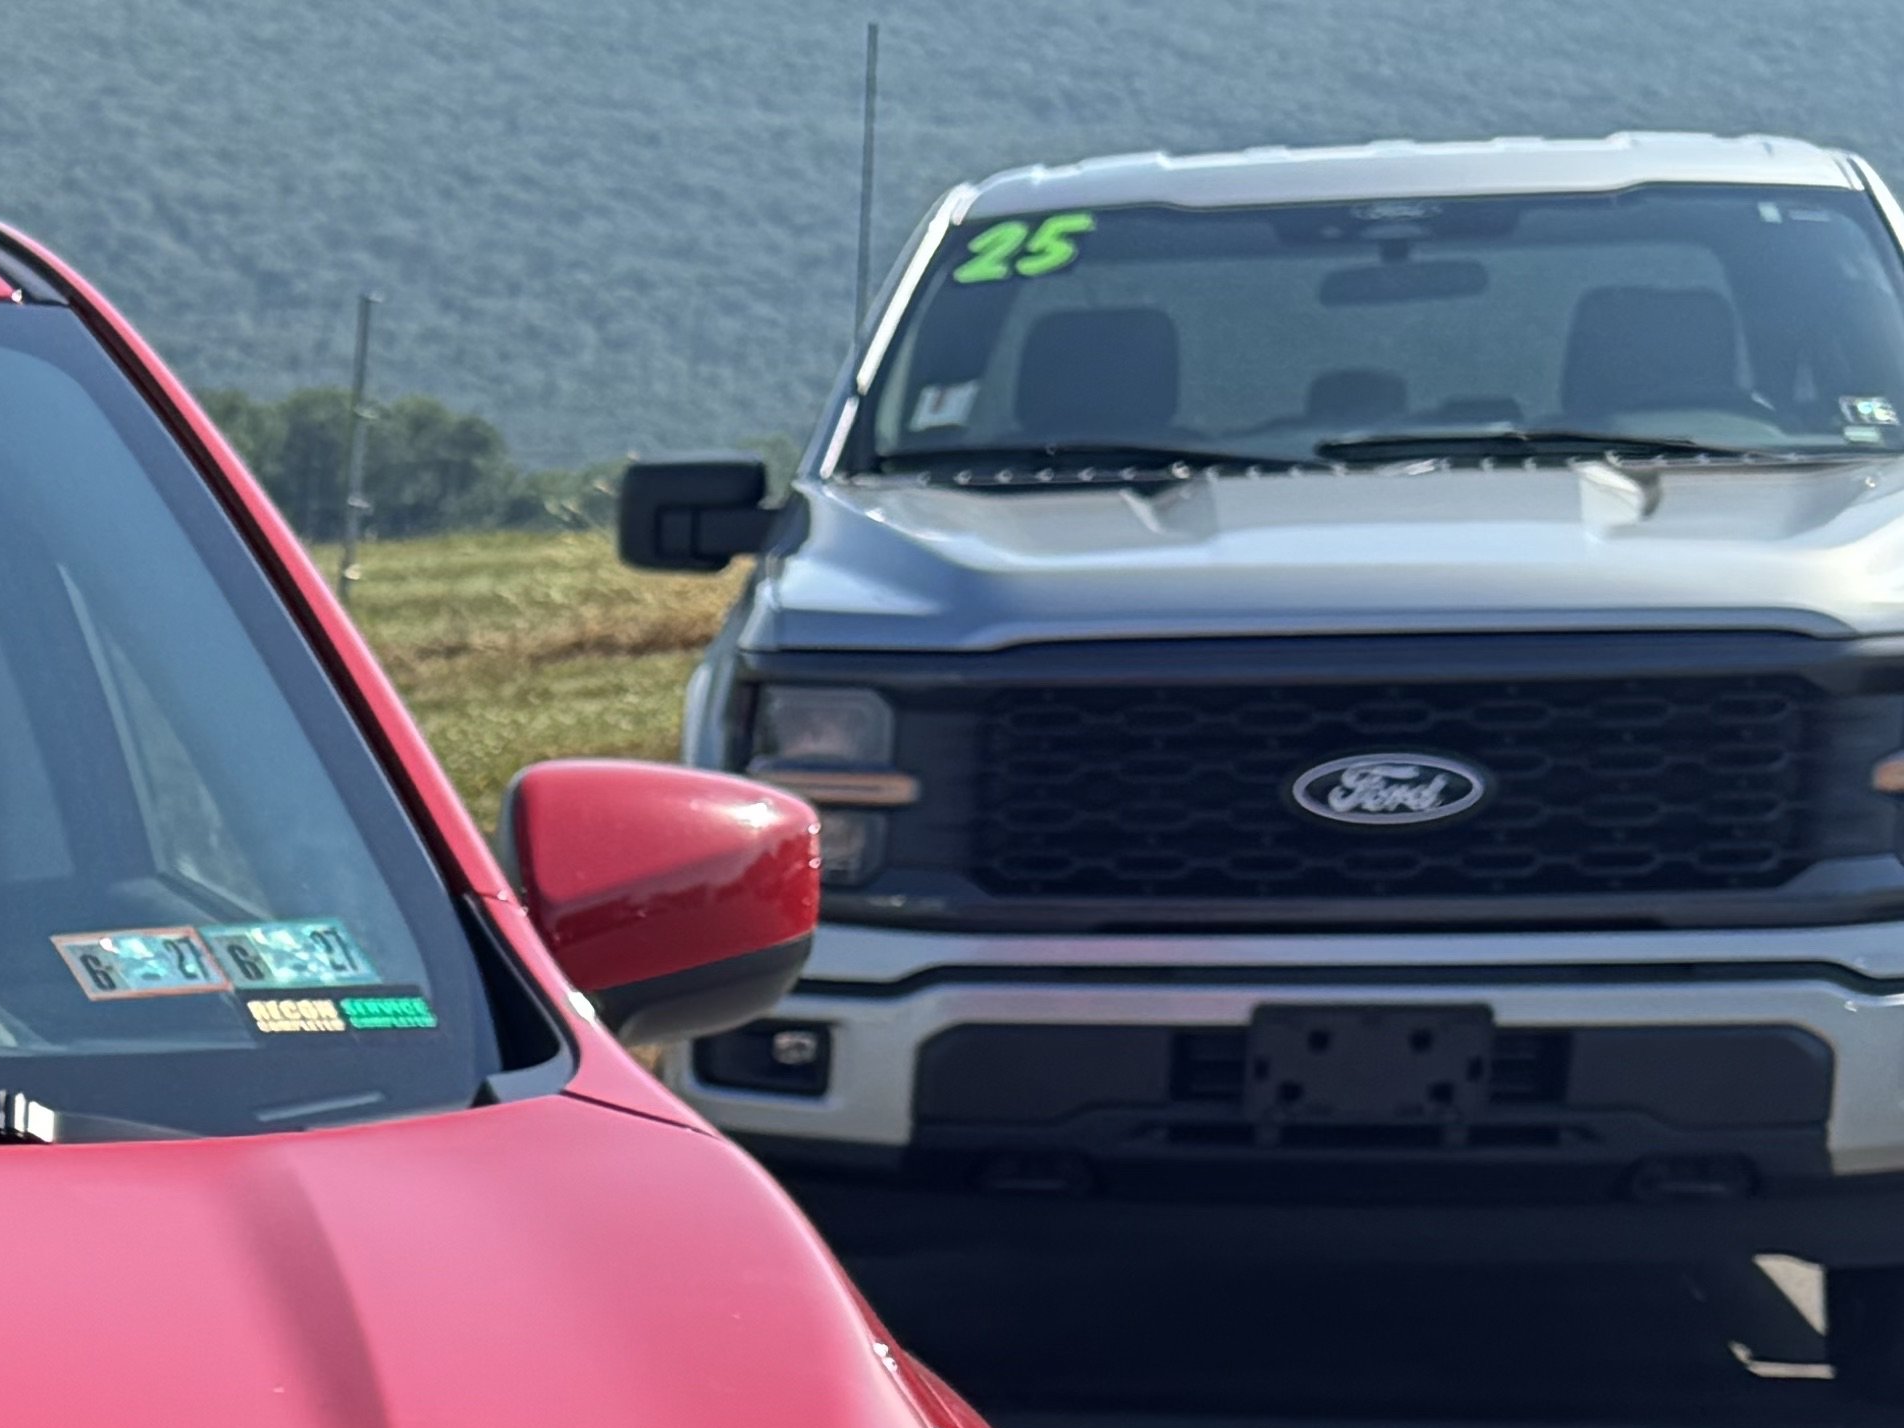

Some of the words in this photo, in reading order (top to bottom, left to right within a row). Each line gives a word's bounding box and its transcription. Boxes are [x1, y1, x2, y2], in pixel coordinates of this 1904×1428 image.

[952, 213, 1096, 284] 25
[1328, 765, 1448, 813] Ford
[162, 935, 210, 981] 27
[226, 943, 266, 981] 6
[309, 927, 358, 972] 27
